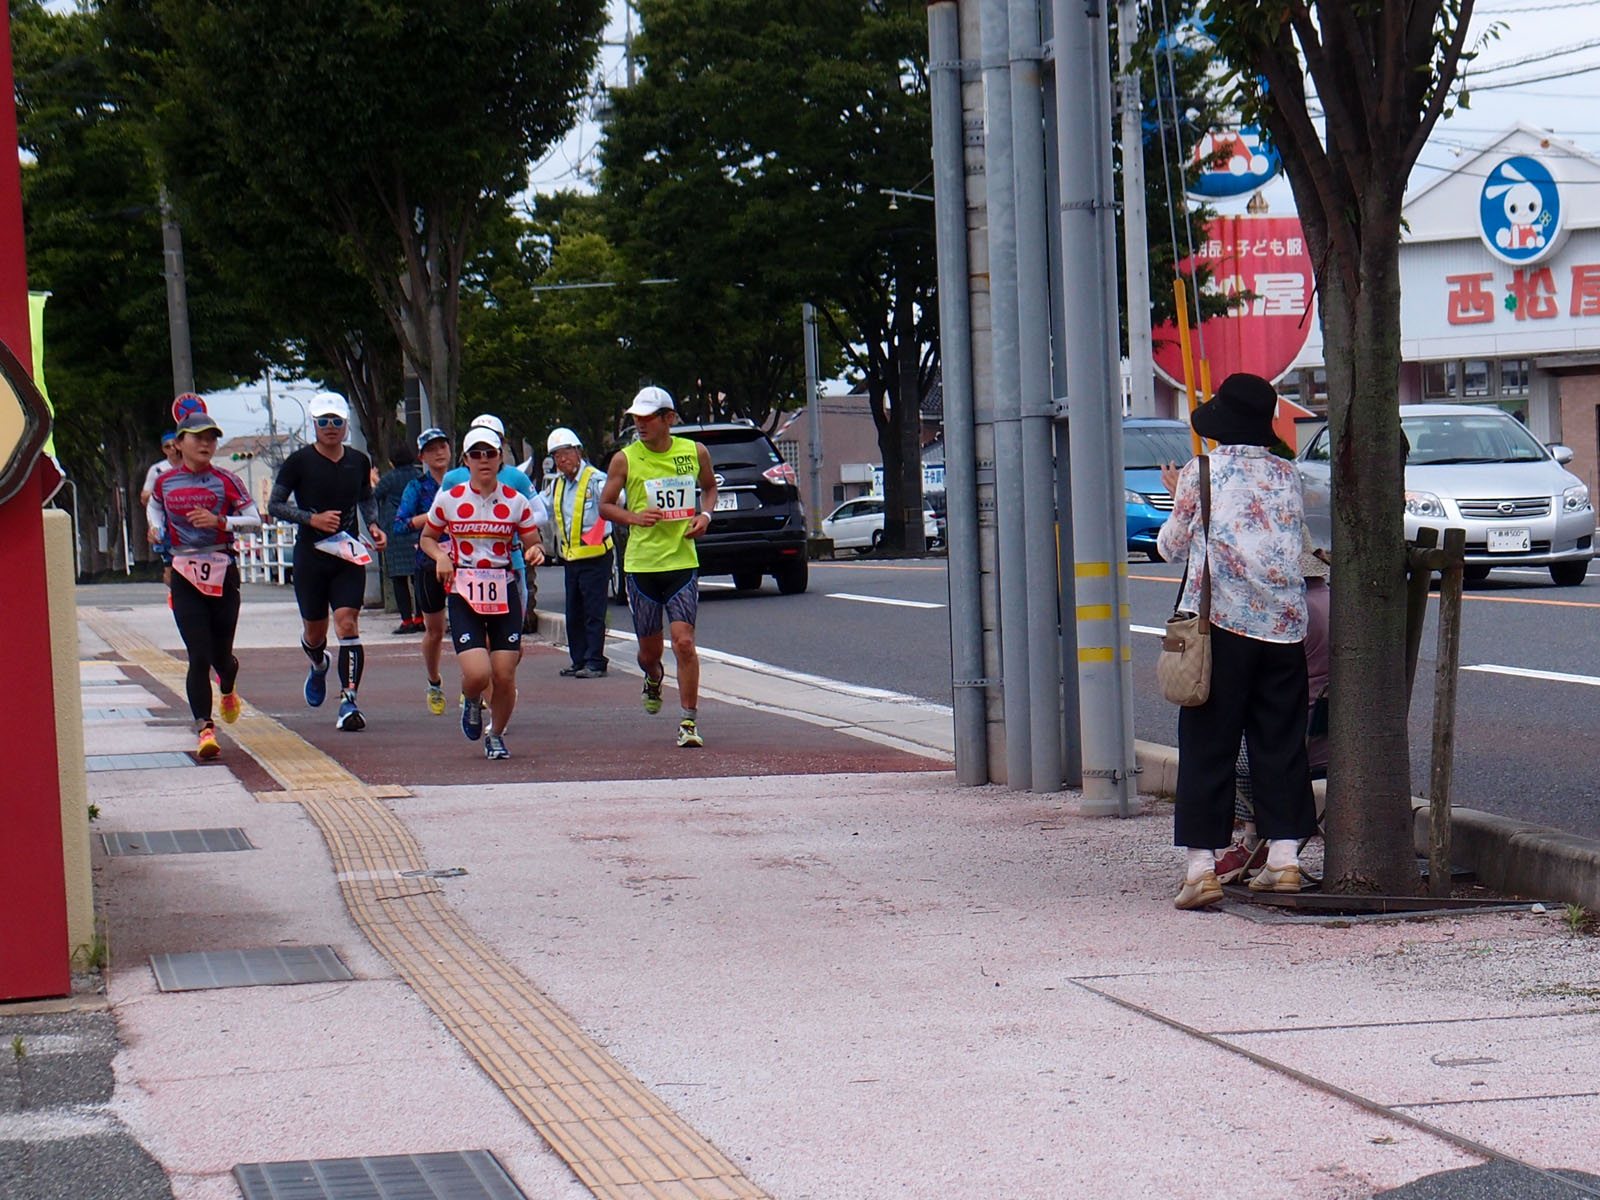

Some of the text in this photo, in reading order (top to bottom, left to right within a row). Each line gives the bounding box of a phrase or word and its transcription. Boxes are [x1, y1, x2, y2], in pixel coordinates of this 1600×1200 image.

[1446, 264, 1600, 325] 西松屋
[656, 488, 685, 509] 567
[452, 522, 513, 534] SUPERMAN
[466, 581, 497, 602] 118
